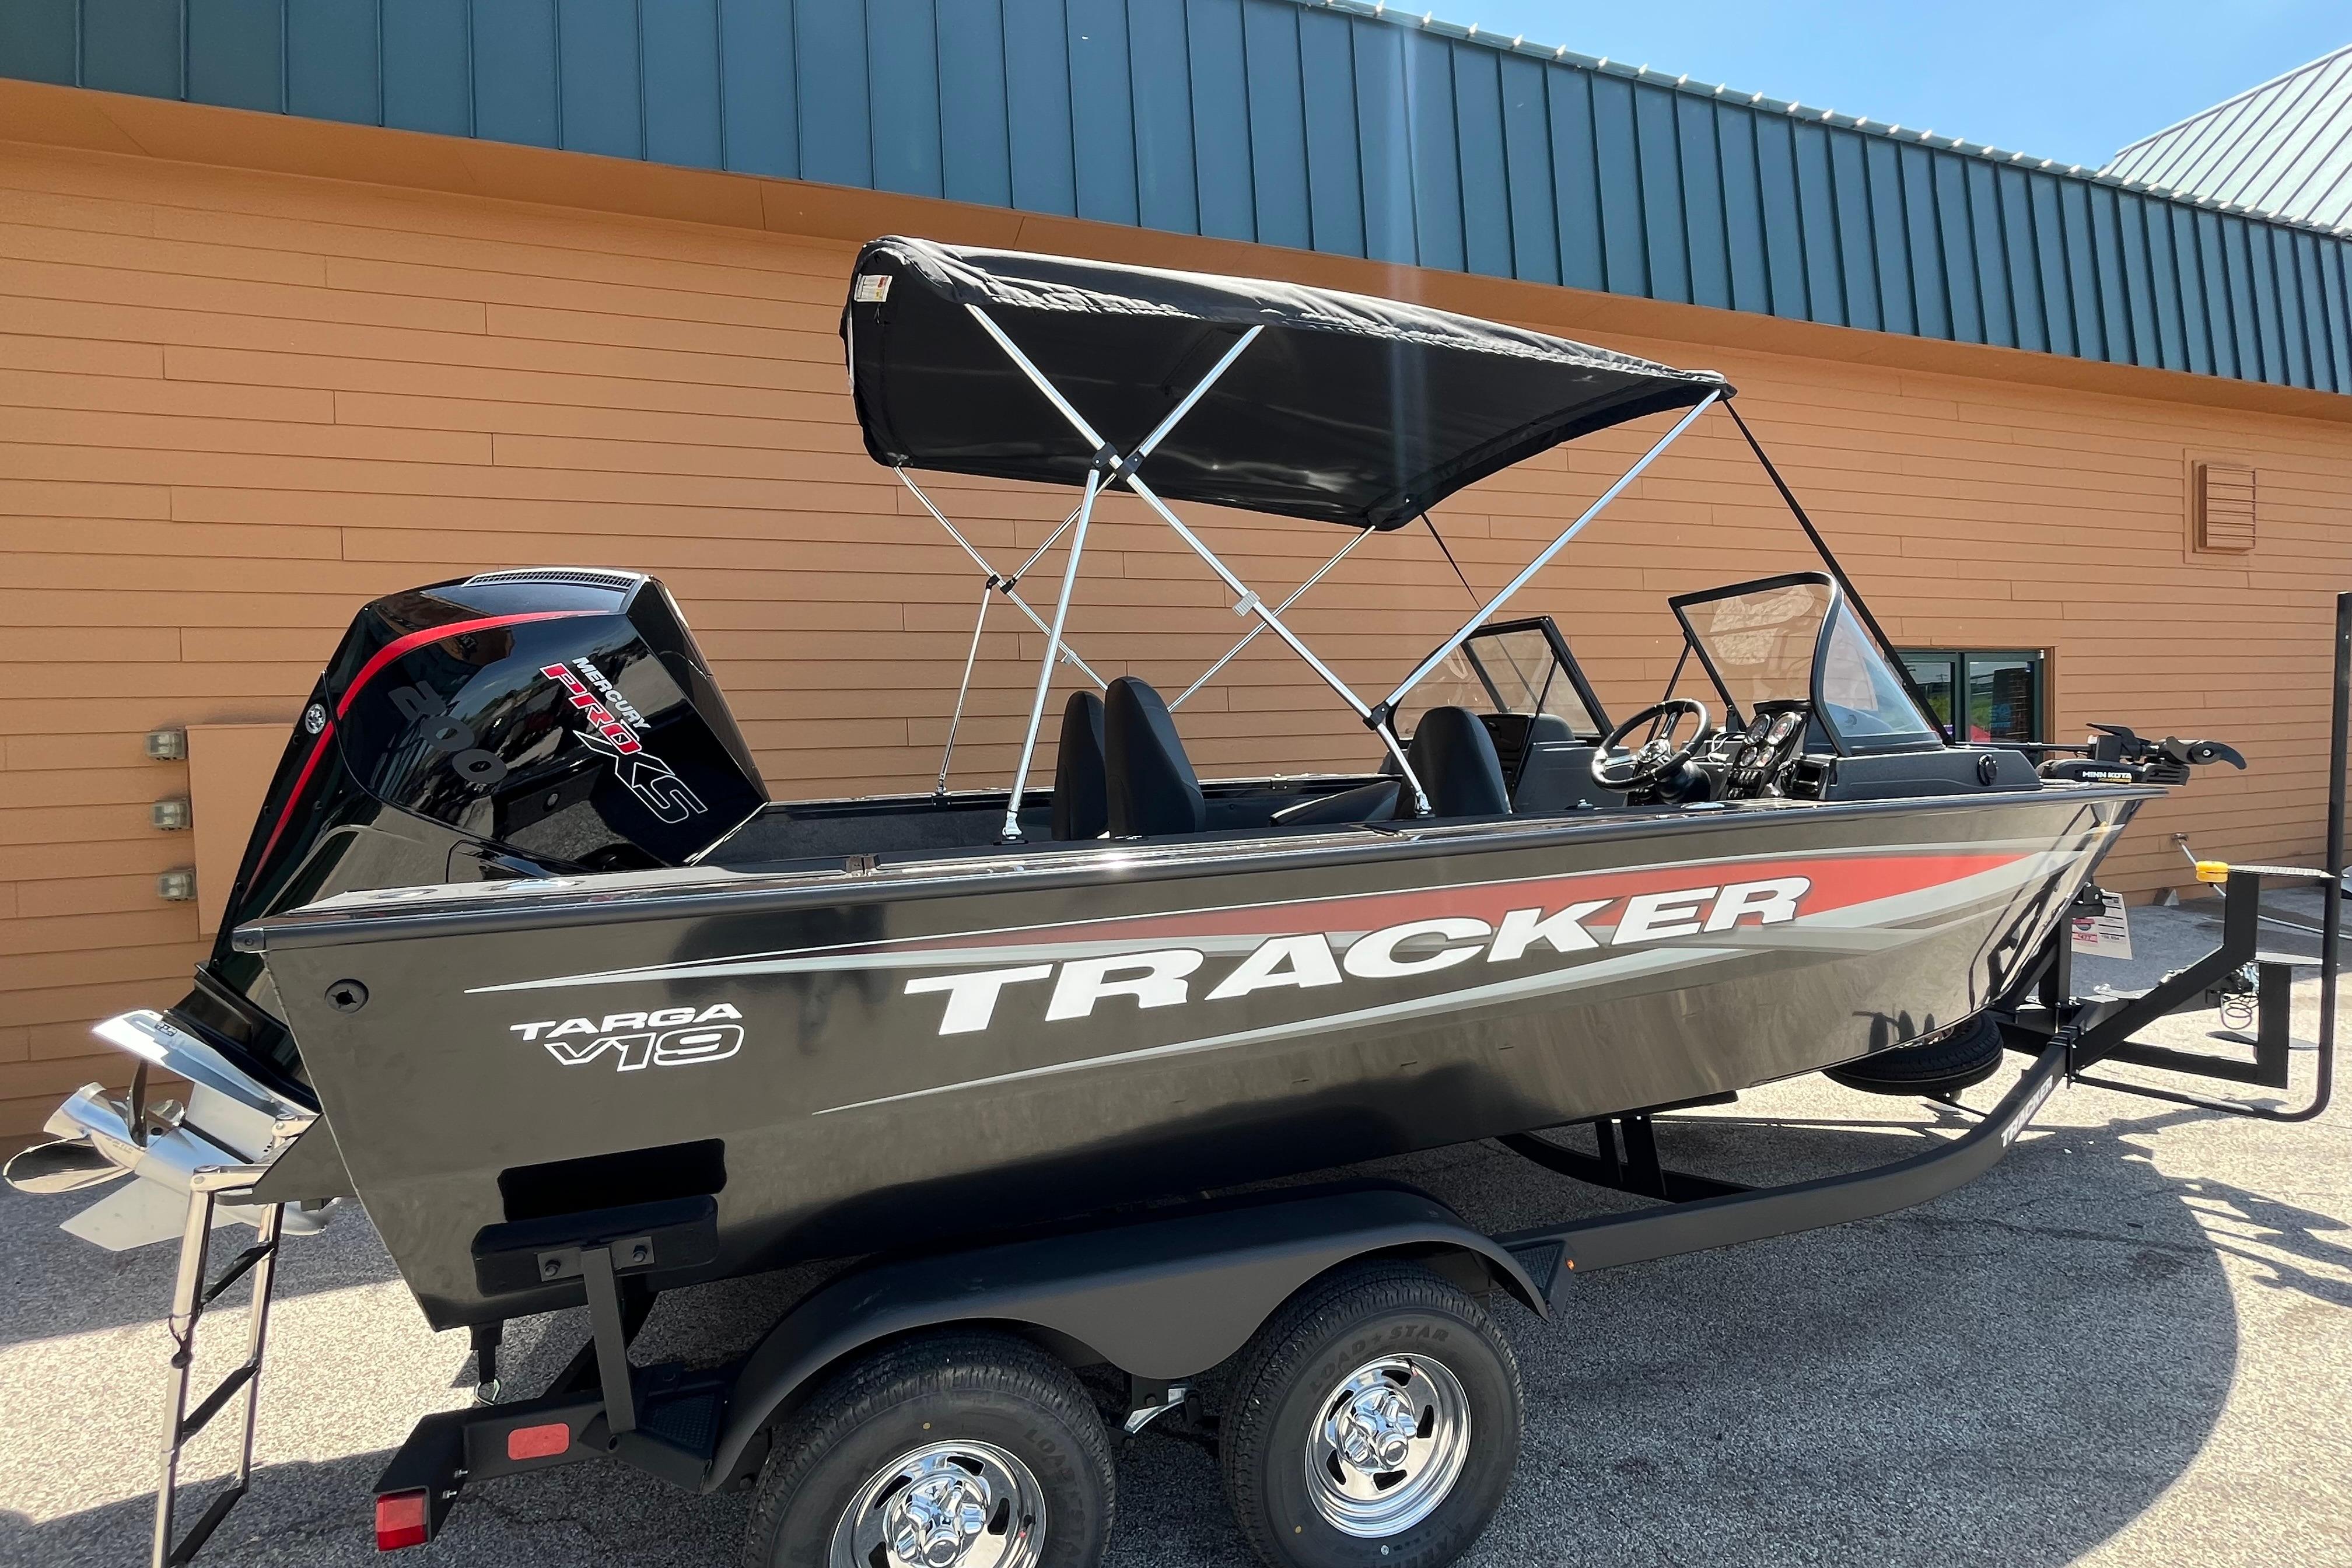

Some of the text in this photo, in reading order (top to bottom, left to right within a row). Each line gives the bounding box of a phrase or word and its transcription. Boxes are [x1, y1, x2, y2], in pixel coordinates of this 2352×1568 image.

[572, 657, 652, 730] MERCURY
[388, 680, 508, 784] 200
[540, 662, 708, 824] PRO XS
[2108, 771, 2132, 779] KOTA
[903, 876, 1812, 1035] TRACKER
[509, 1003, 743, 1041] TARGA
[544, 1024, 745, 1072] V19
[2000, 1074, 2053, 1147] TRACKER
[1310, 1324, 1450, 1394] LOAD STAR
[1023, 1429, 1076, 1483] LOAD
